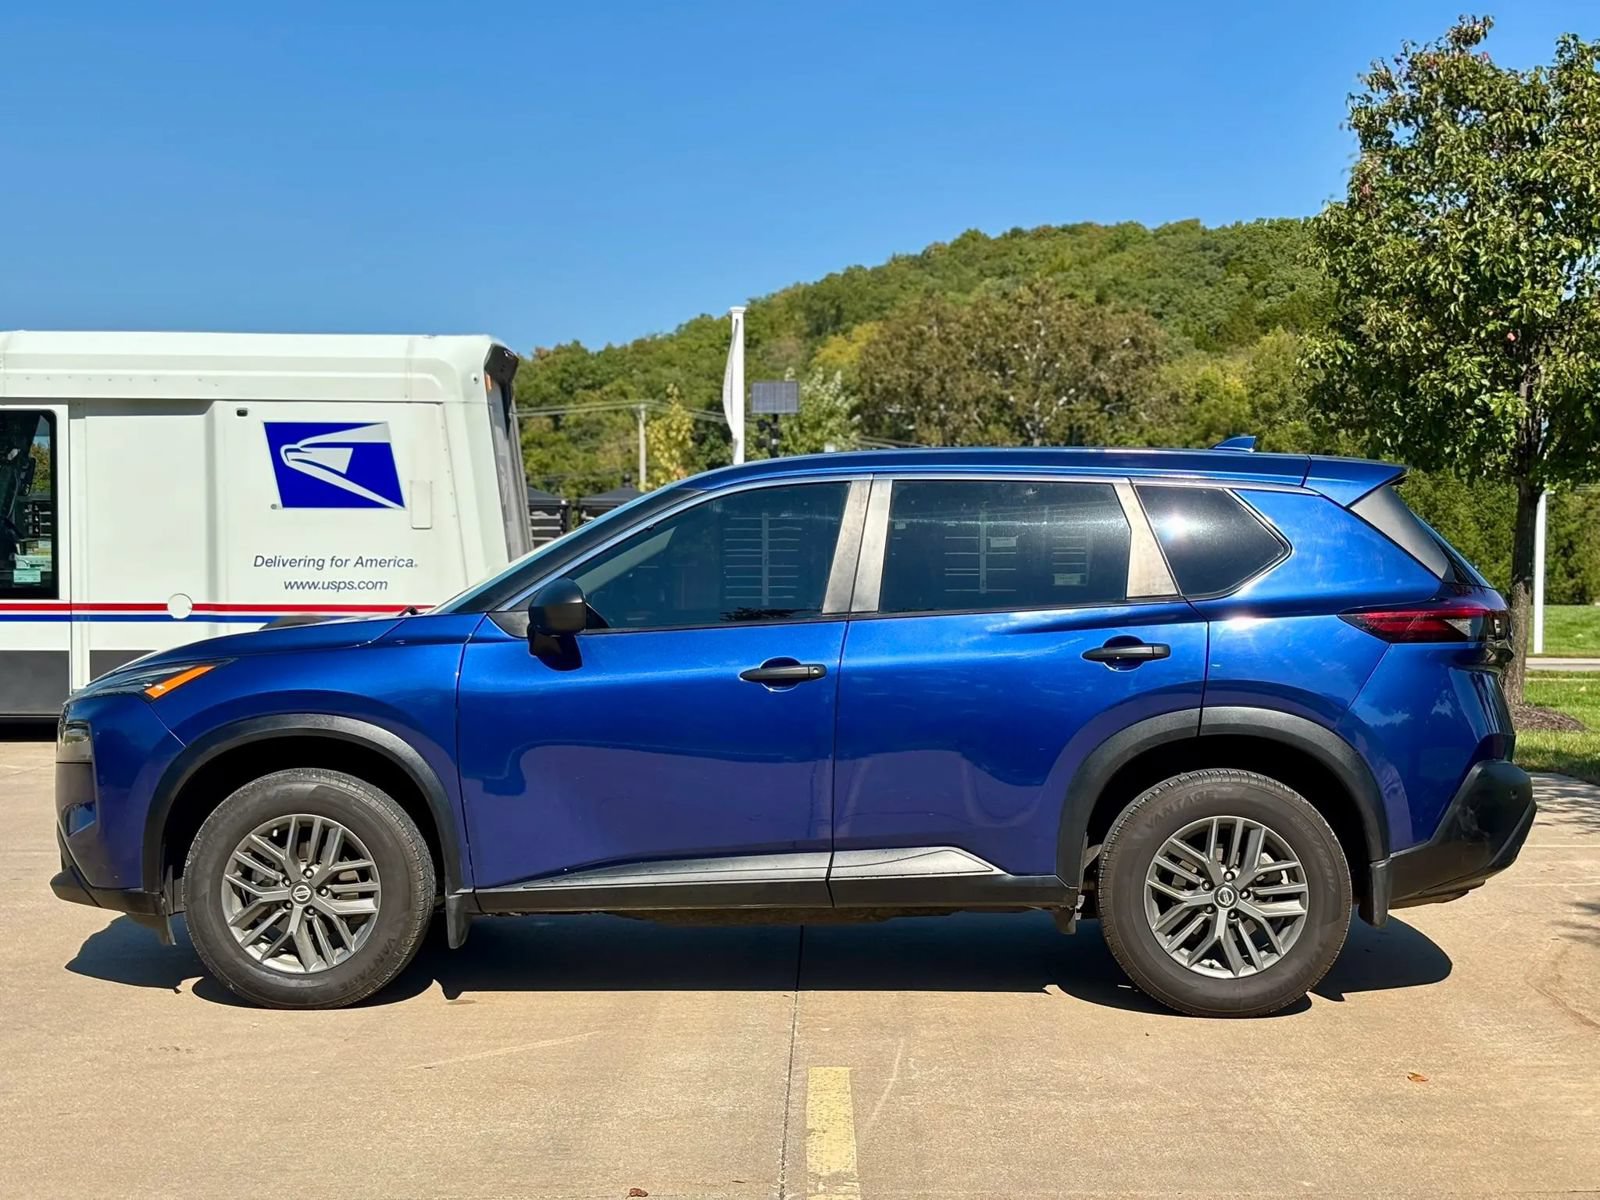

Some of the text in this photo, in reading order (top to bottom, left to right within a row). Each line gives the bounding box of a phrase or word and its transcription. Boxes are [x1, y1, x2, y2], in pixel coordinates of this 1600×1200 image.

[253, 555, 326, 571] Delivering
[329, 555, 351, 568] for
[283, 580, 388, 592] www.usps.com
[339, 938, 397, 991] VANTAGE
